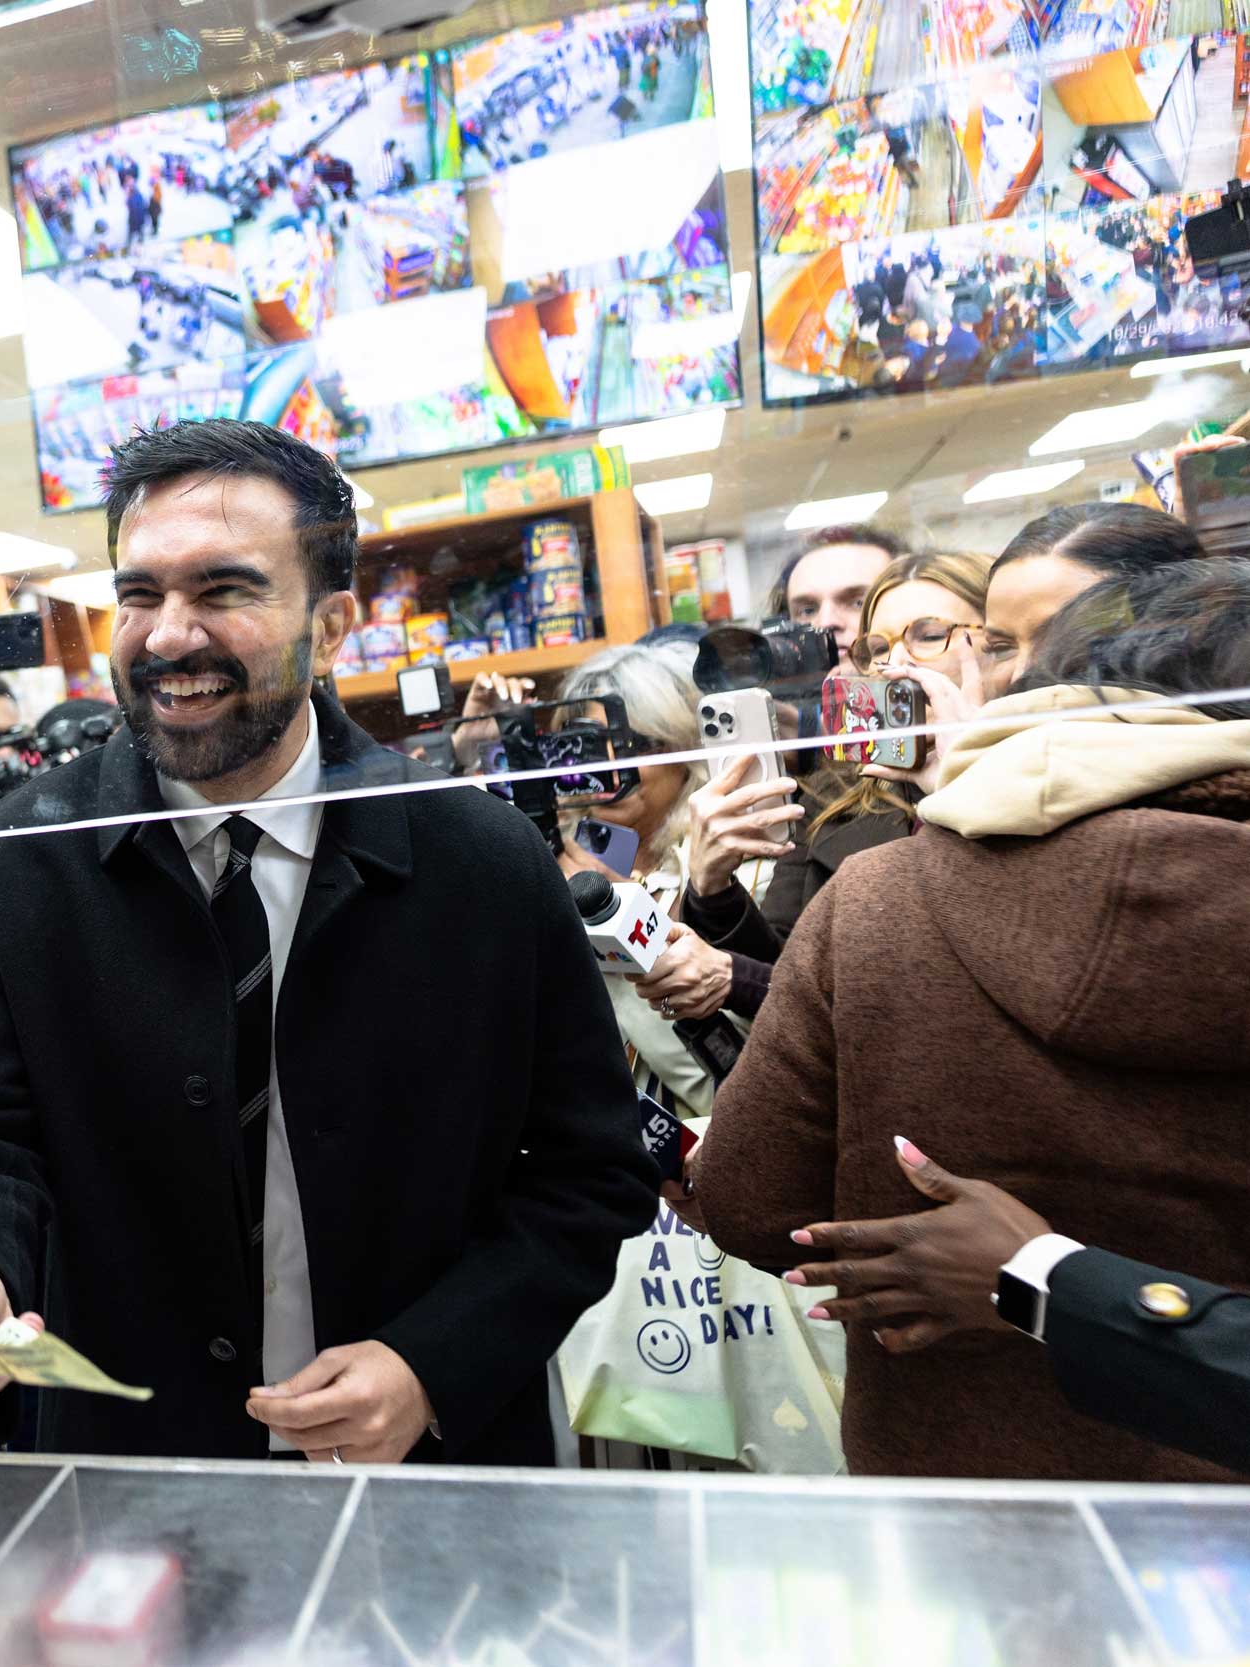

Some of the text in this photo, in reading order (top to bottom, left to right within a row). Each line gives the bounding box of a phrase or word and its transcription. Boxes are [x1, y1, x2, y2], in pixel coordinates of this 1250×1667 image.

[646, 911, 658, 936] 47
[652, 1126, 677, 1153] YORK
[649, 1241, 671, 1271] A
[641, 1276, 723, 1309] NICE
[700, 1304, 774, 1344] DAY!
